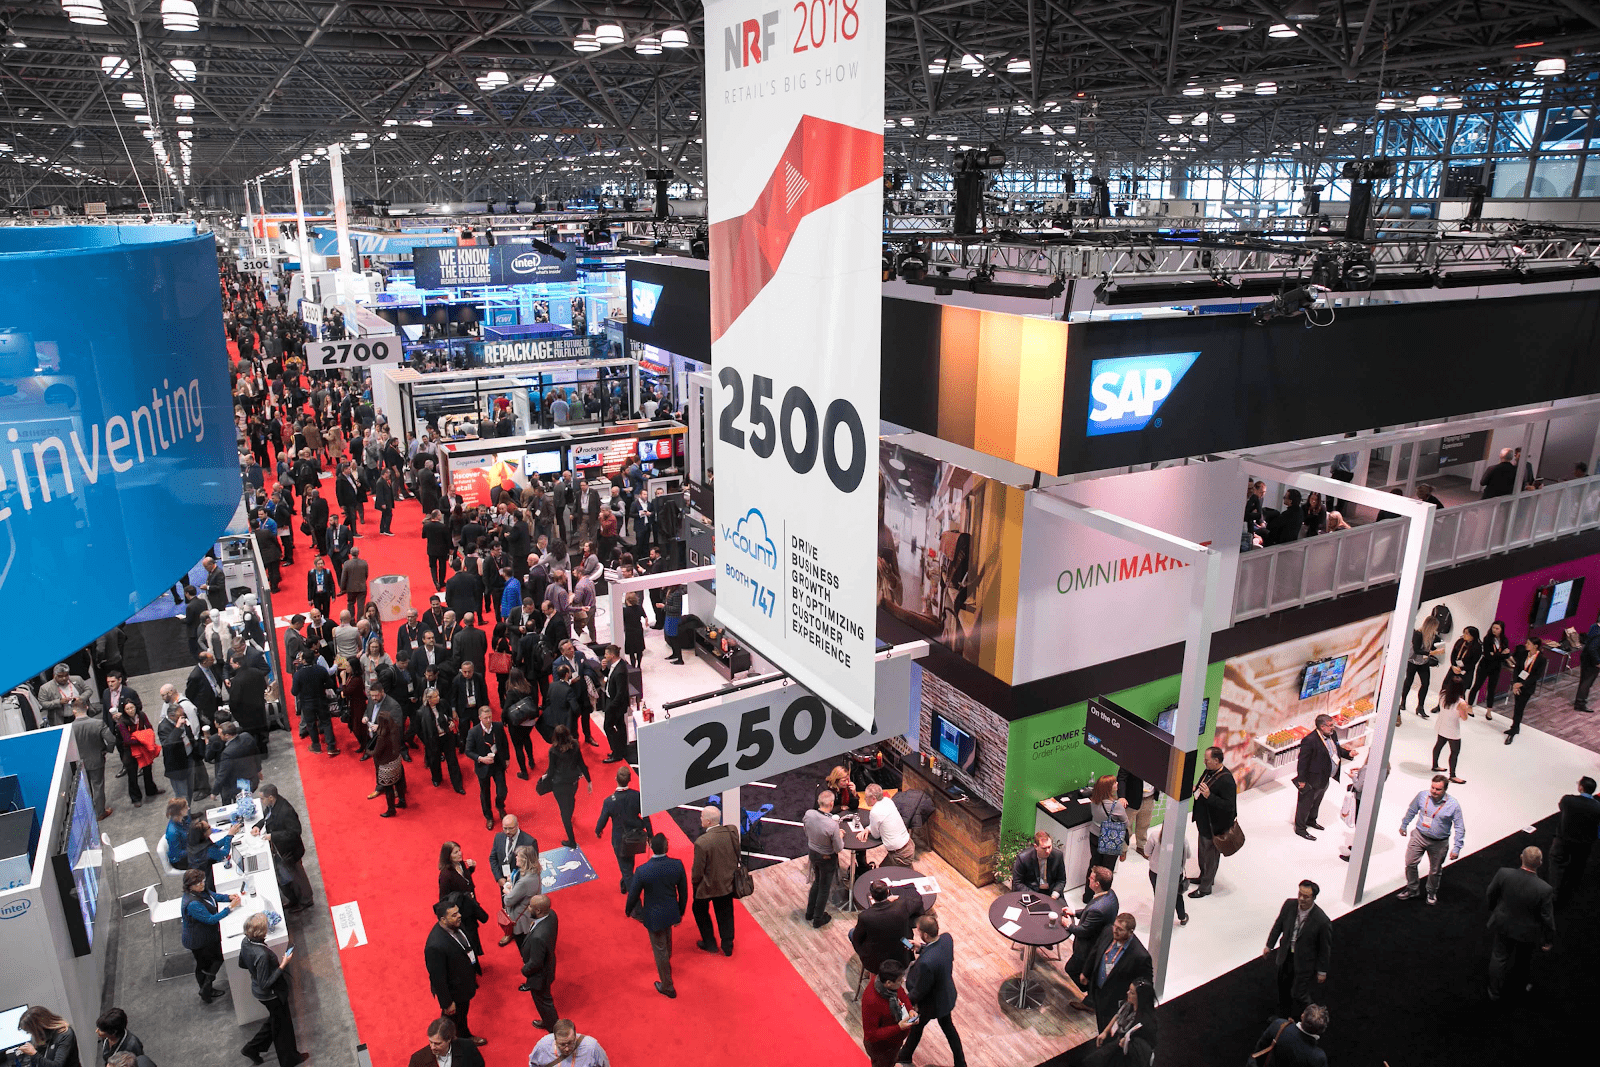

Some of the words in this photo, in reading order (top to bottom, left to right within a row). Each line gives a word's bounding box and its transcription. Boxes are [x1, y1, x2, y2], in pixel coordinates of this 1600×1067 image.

[724, 9, 779, 72] NRF
[793, 0, 859, 54] 2018
[724, 80, 776, 104] RETAIL'S
[784, 73, 806, 93] BIG
[815, 61, 859, 87] SHOW
[438, 249, 457, 265] WE
[457, 248, 490, 265] KNOW
[514, 256, 537, 268] intel
[439, 265, 457, 279] THE
[458, 264, 491, 278] FUTURE
[632, 287, 657, 319] SAP
[321, 341, 389, 365] 2700
[484, 341, 554, 364] REPACKAGE
[563, 339, 582, 348] FUTURE
[553, 346, 591, 358] FULFILLMENT
[1089, 368, 1172, 422] SAP
[717, 365, 867, 494] 2500
[582, 445, 609, 453] rackspace
[791, 535, 818, 561] DRIVE
[791, 552, 840, 589] BUSINESS
[725, 563, 750, 589] BOOTH
[750, 578, 776, 619] 747
[791, 569, 831, 602] GROWTH
[792, 586, 804, 603] BY
[805, 595, 865, 641] OPTIMIZING
[792, 603, 843, 646] CUSTOMER
[792, 620, 851, 669] EXPERIENCE
[1090, 706, 1100, 717] On
[1100, 711, 1111, 723] the
[1111, 718, 1121, 729] Go
[1032, 748, 1053, 761] Order
[1056, 740, 1080, 754] Pickup
[1033, 729, 1080, 750] CUSTOMER
[0, 902, 27, 916] intel
[339, 913, 348, 929] SILVER
[345, 905, 356, 927] SPONSOR
